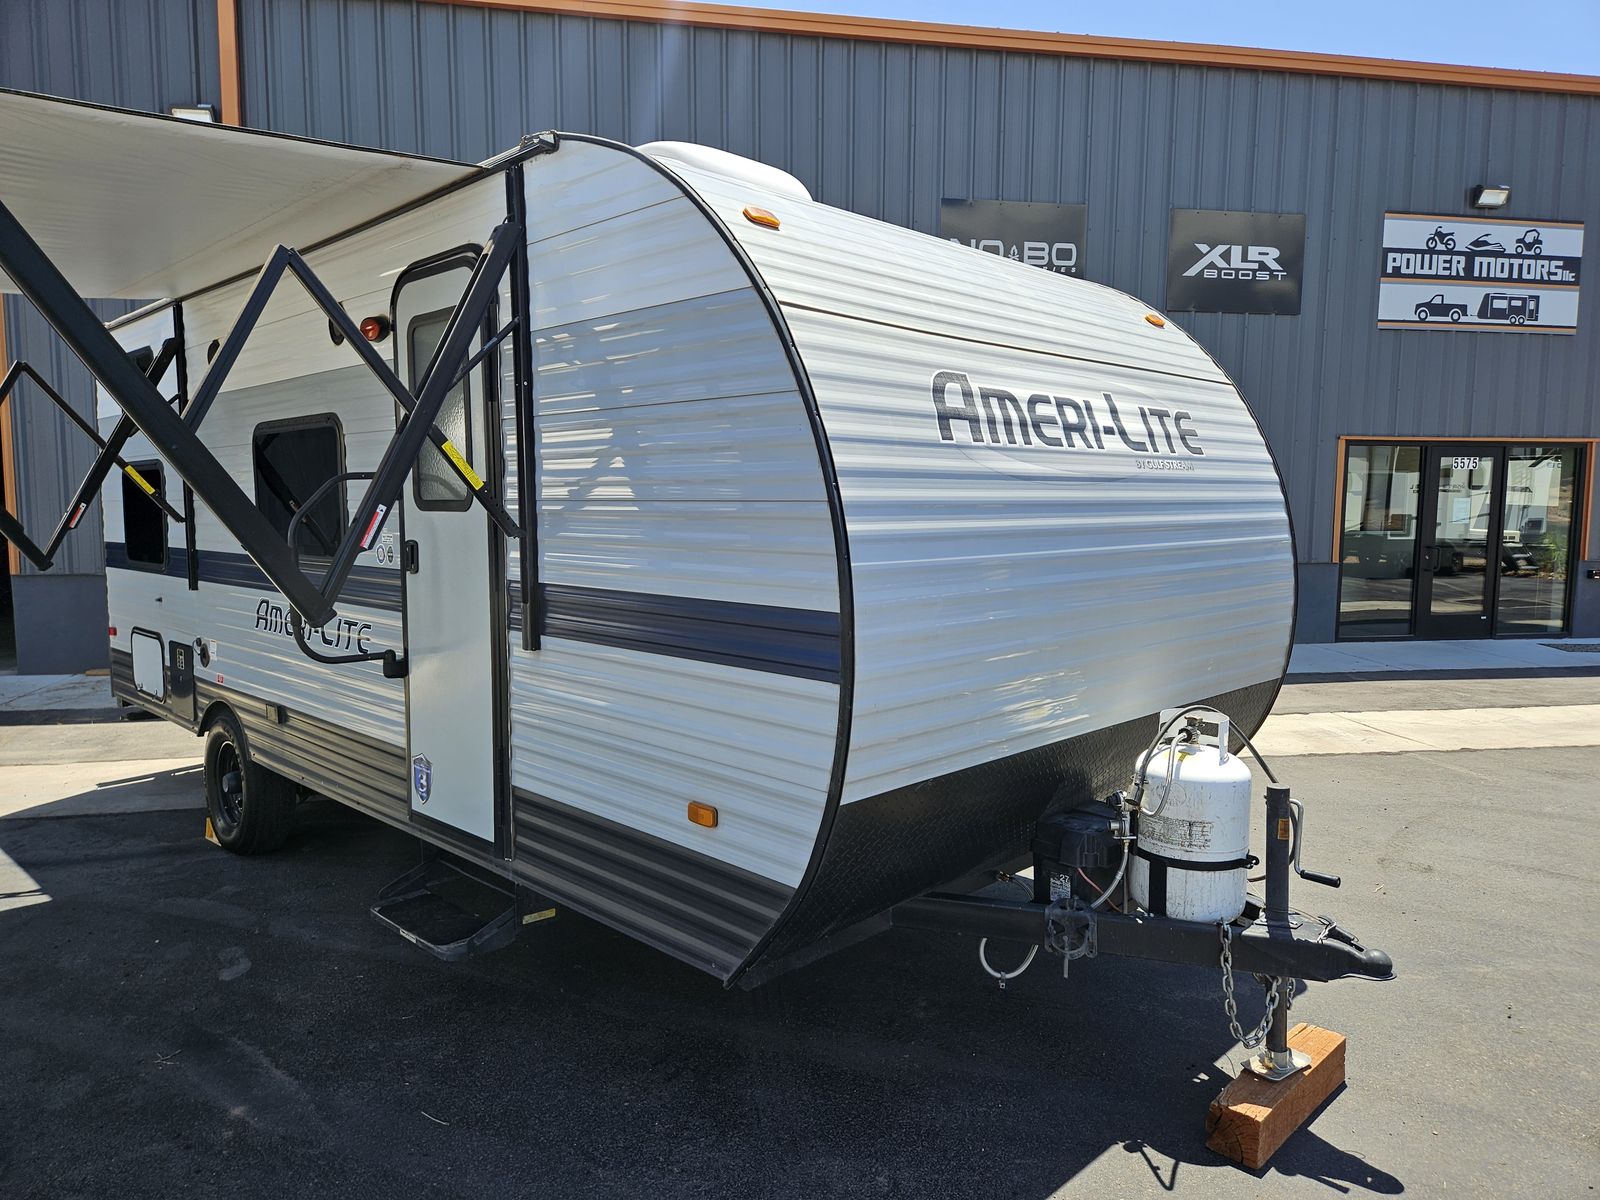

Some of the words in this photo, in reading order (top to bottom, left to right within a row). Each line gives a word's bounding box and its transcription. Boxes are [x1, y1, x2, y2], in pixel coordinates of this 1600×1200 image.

[1181, 243, 1284, 277] XLR
[1386, 252, 1466, 277] POWER
[1473, 256, 1563, 281] MOTORS
[1203, 269, 1287, 281] BOOST
[930, 369, 1205, 455] AMERI-LITE
[1453, 457, 1478, 469] 5575
[1059, 874, 1070, 883] 27
